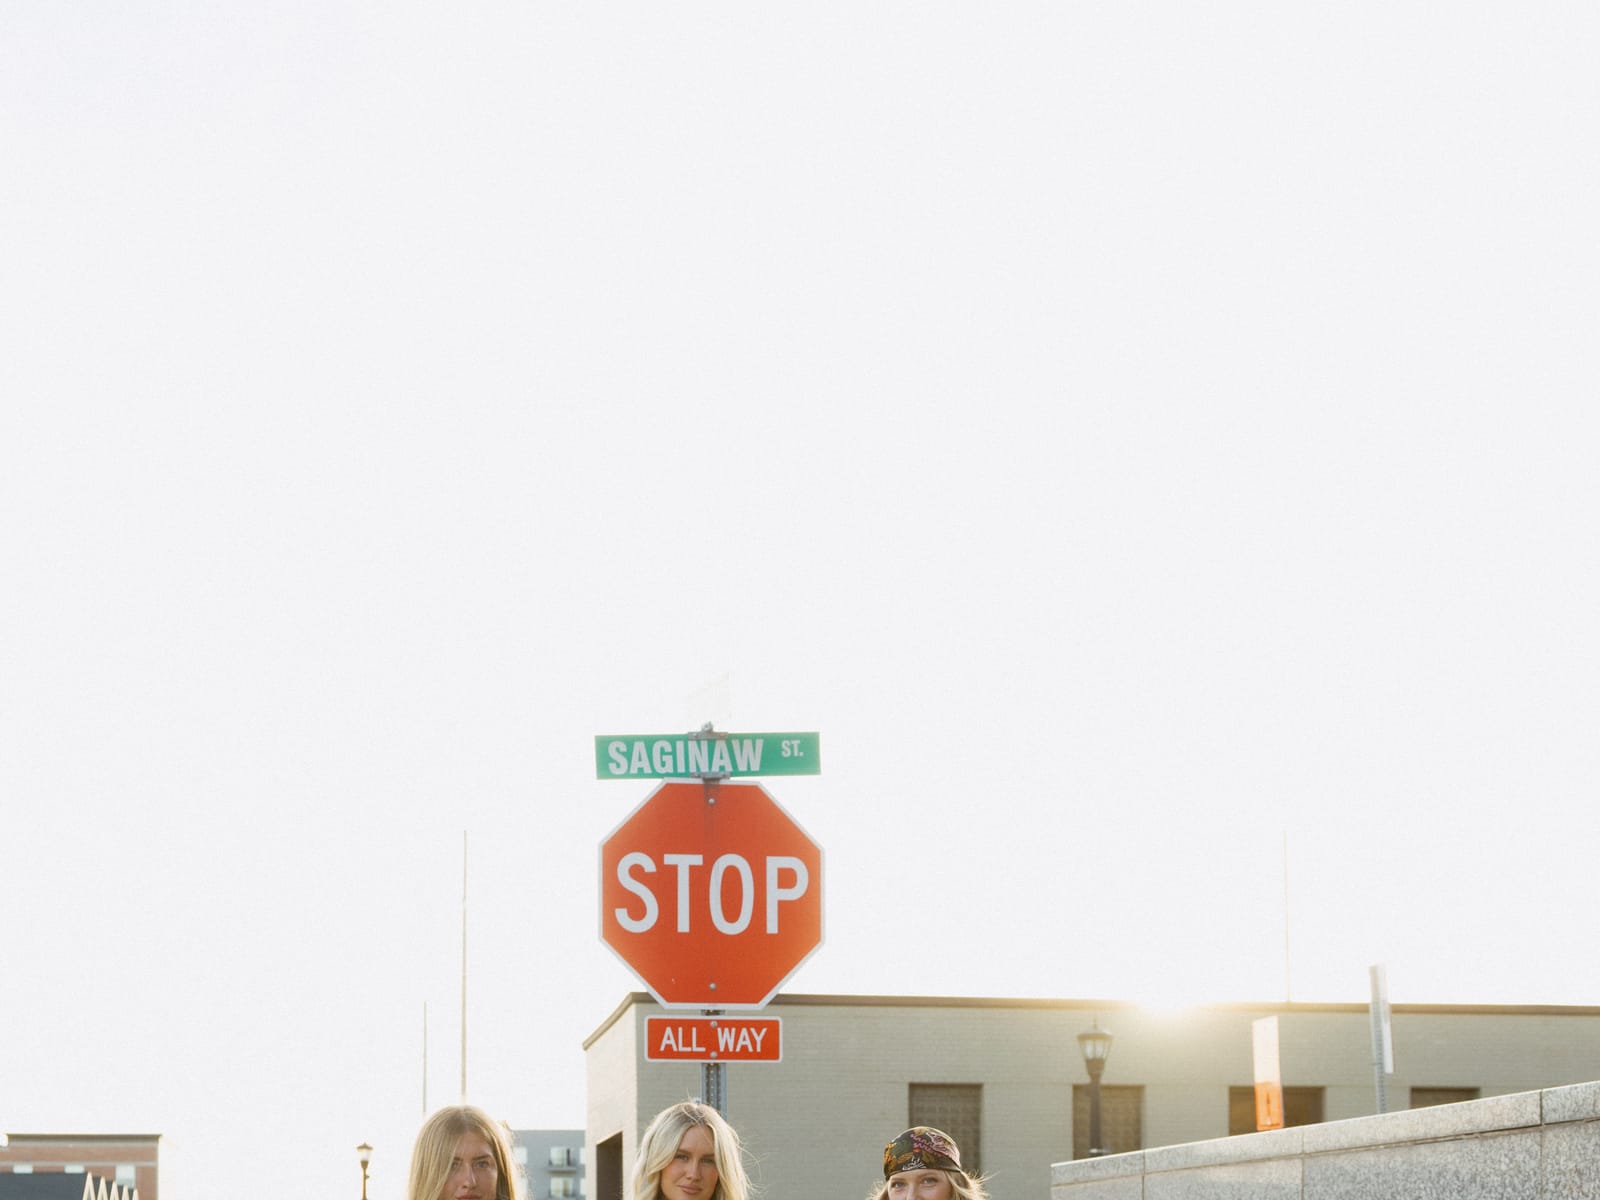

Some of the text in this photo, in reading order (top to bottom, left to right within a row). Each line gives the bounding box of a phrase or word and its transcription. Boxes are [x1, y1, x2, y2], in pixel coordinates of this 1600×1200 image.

[608, 739, 804, 775] SAGINAW ST.
[615, 852, 809, 935] STOP
[660, 1026, 768, 1054] ALL WAY
